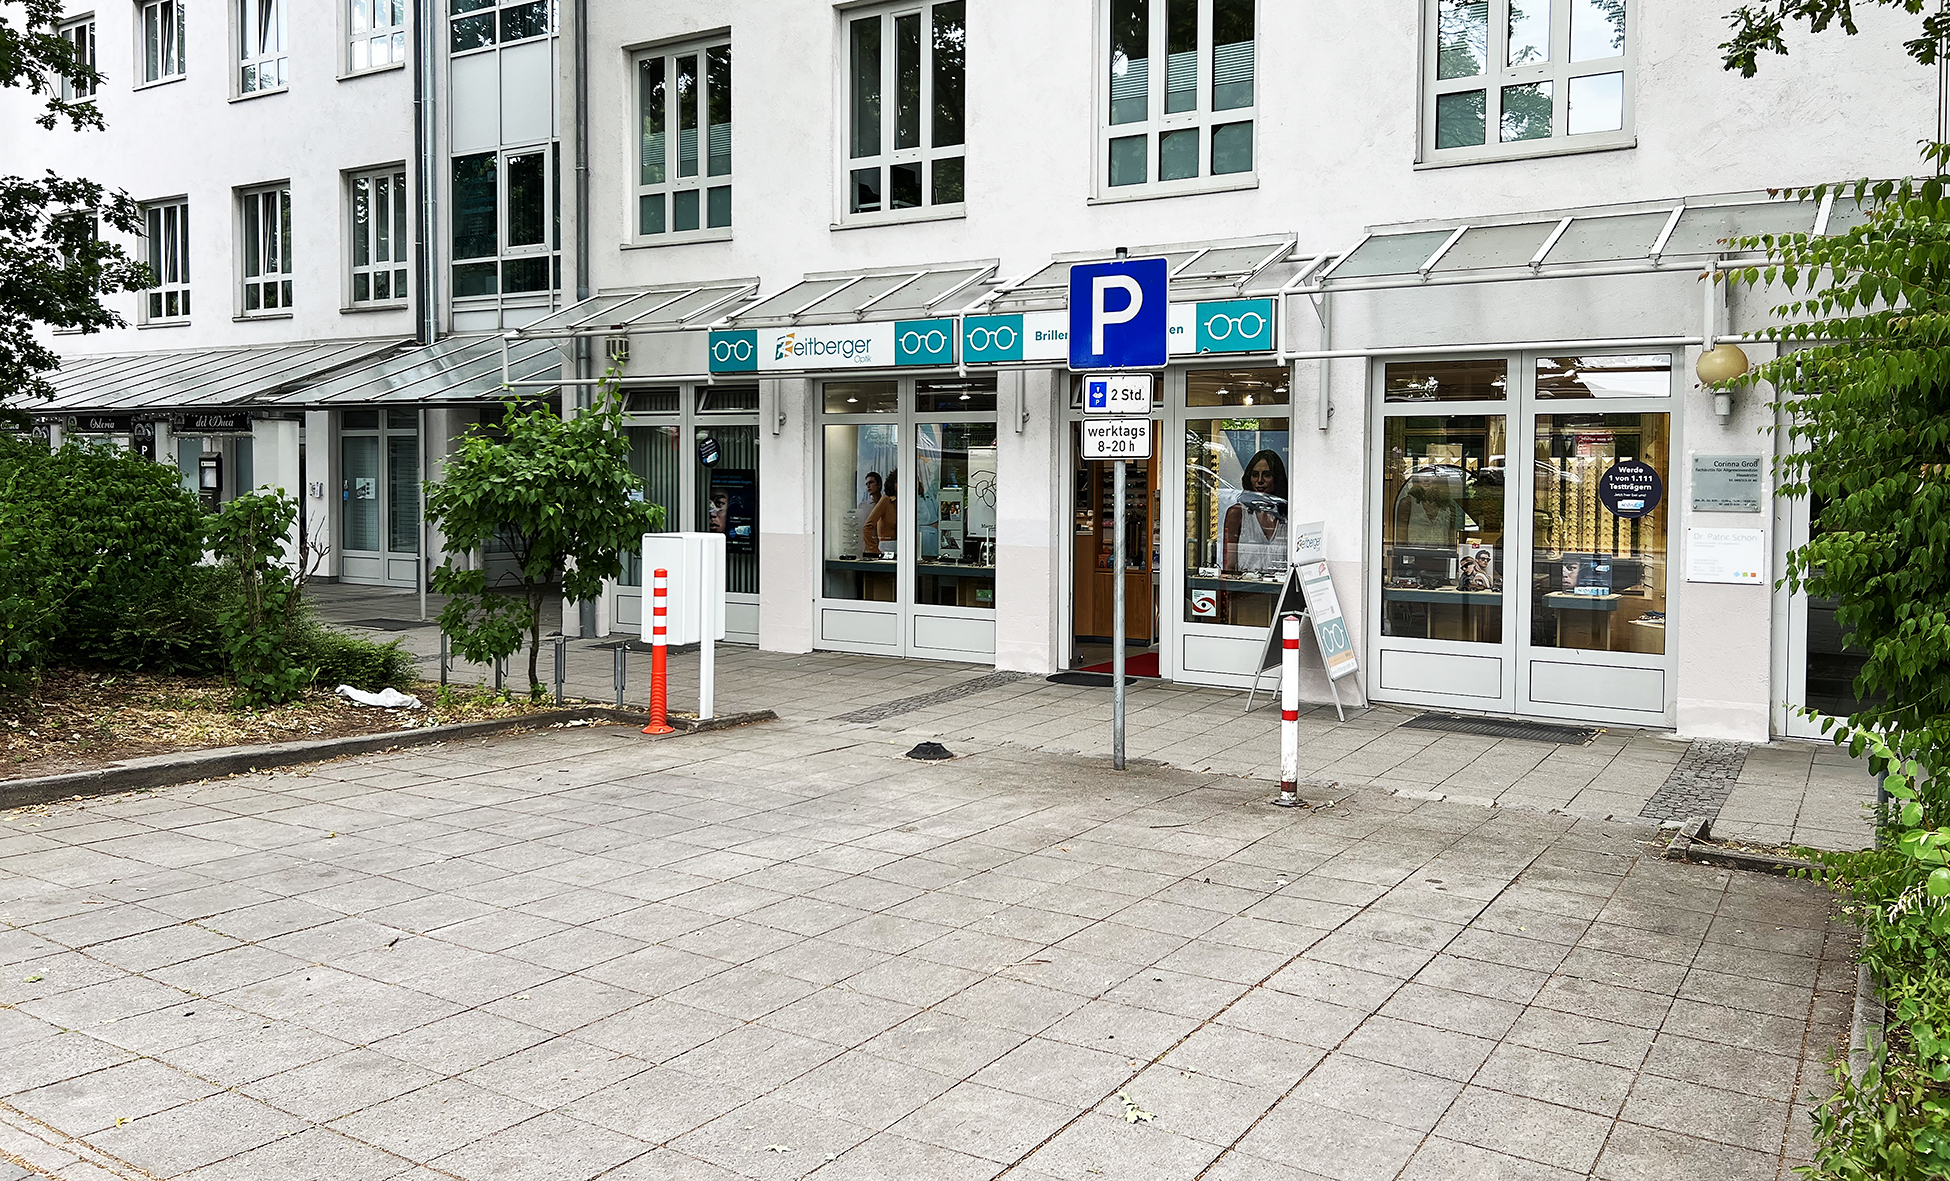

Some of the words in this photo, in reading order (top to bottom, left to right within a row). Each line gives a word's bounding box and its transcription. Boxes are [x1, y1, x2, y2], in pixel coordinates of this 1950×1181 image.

[1091, 275, 1144, 356] P
[854, 355, 872, 364] Optik
[1111, 389, 1118, 401] 2
[1121, 389, 1145, 401] Std.
[90, 418, 115, 429] Osteria
[1088, 425, 1146, 439] werktags
[141, 445, 148, 455] P
[1098, 440, 1126, 453] 8-20
[1129, 440, 1135, 452] h
[1713, 460, 1740, 468] Corinna
[1741, 460, 1759, 468] Groß
[1608, 474, 1613, 482] 1
[1631, 474, 1653, 482] 1.111
[1609, 483, 1652, 492] Testträgern
